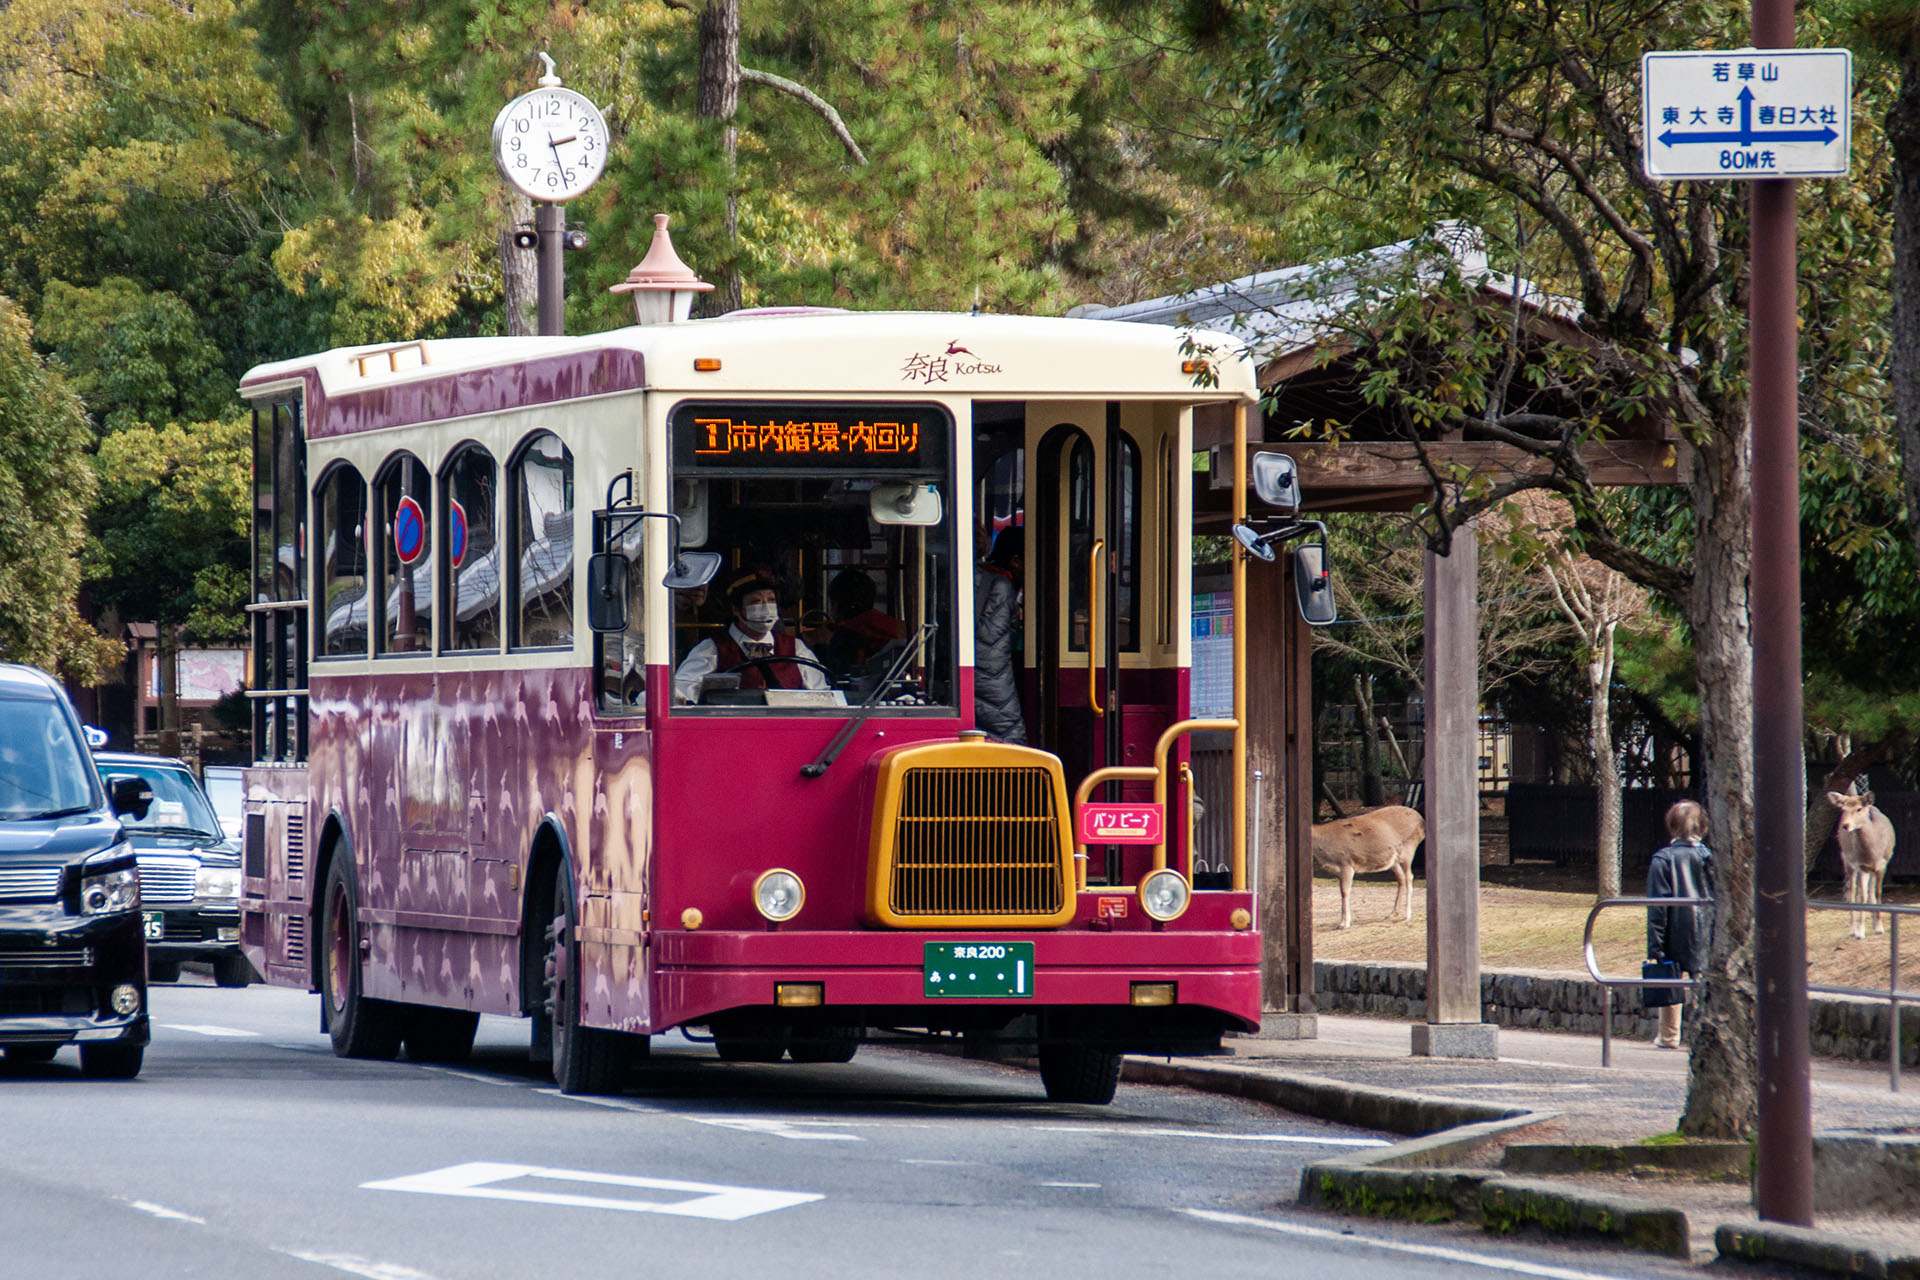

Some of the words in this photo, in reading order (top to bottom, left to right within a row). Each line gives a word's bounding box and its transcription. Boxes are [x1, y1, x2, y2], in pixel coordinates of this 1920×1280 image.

[1712, 62, 1779, 82] 若草山
[530, 104, 541, 120] 11
[545, 100, 561, 116] 12
[1662, 106, 1735, 125] 東大寺
[1758, 105, 1839, 125] 春日大社
[515, 118, 530, 133] 10
[579, 117, 589, 132] 2
[510, 136, 521, 151] 9
[583, 136, 595, 151] 3
[516, 153, 528, 168] 8
[578, 154, 589, 168] 4
[1719, 149, 1777, 169] 80M先
[531, 168, 541, 182] 7
[547, 172, 558, 187] 6
[565, 167, 576, 182] 5
[900, 353, 949, 385] 奈良
[955, 362, 1003, 375] Kotsu
[953, 946, 1006, 959] 奈良200
